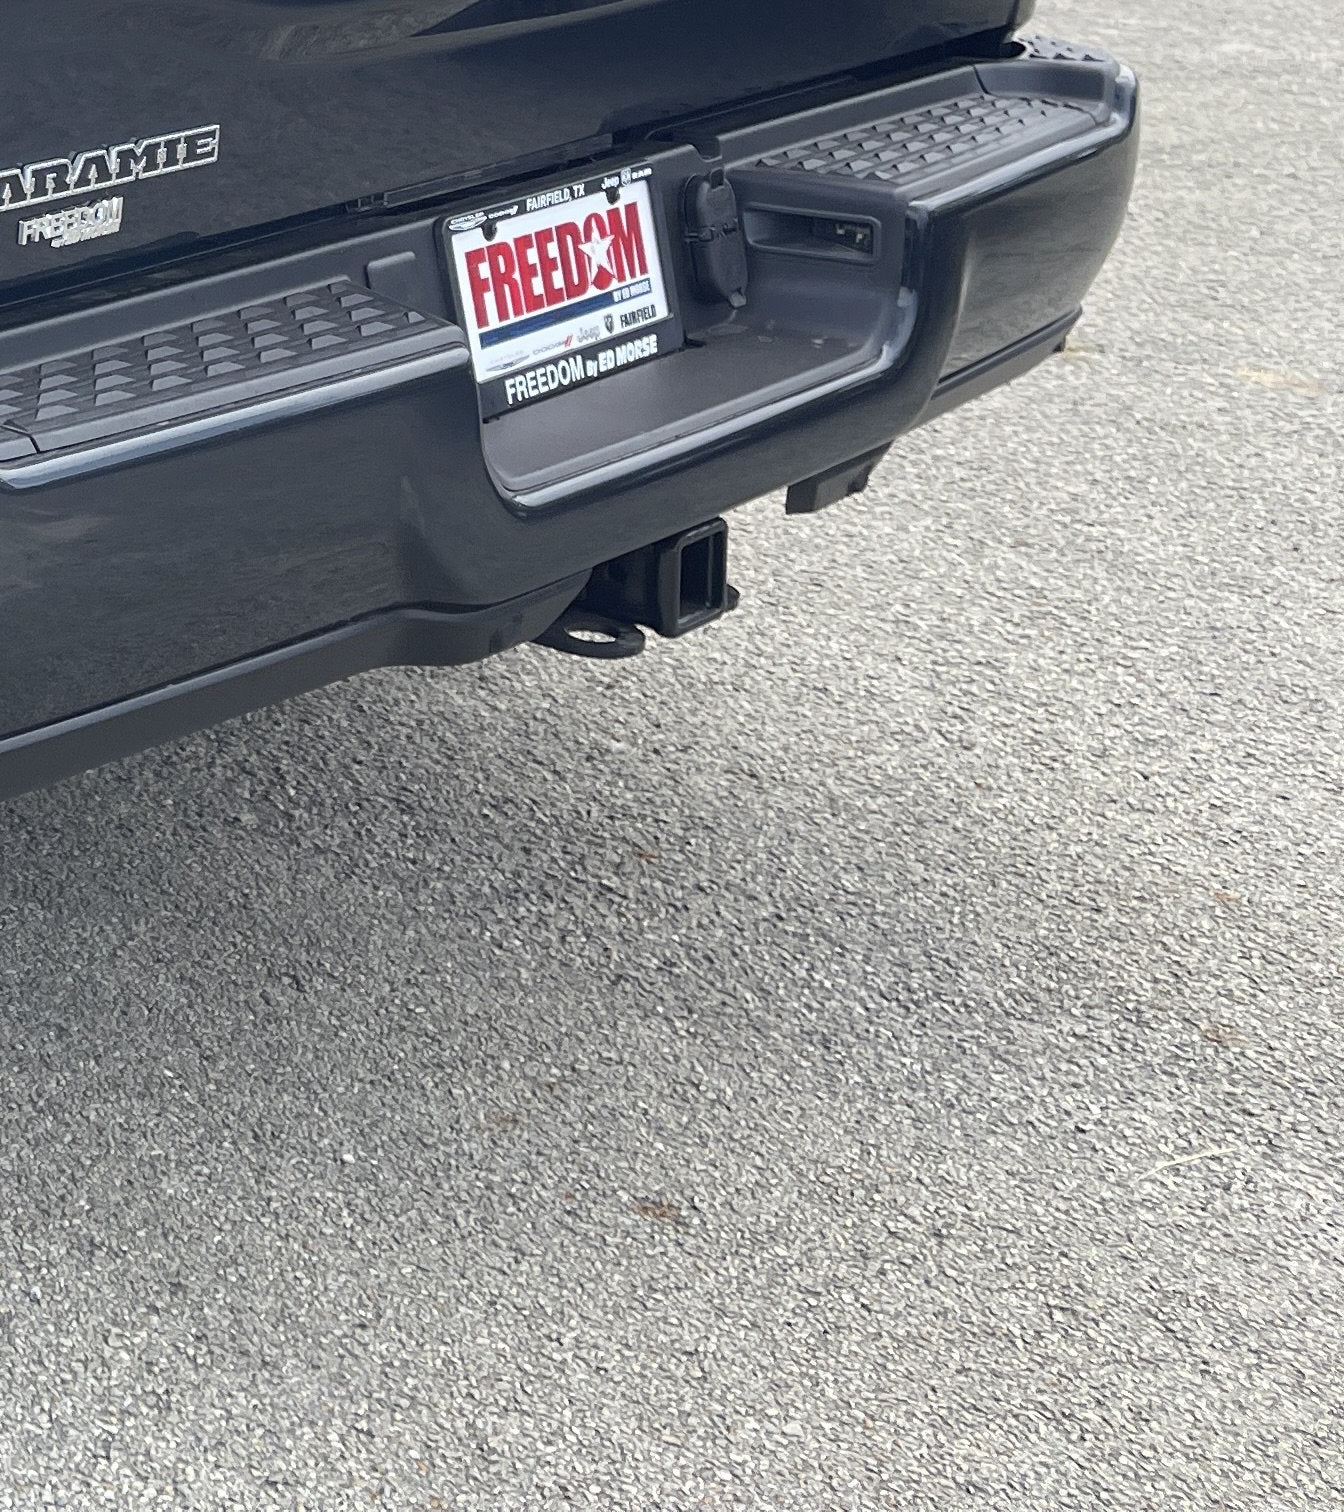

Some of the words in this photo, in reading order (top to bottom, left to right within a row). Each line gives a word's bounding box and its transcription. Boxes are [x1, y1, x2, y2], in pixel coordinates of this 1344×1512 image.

[572, 183, 585, 198] TX
[18, 197, 124, 245] FREEDOM
[465, 201, 649, 329] FREEDOM
[620, 304, 657, 329] FAIRFIELD
[504, 355, 585, 405] FREEDOM
[598, 349, 615, 372] ED
[616, 334, 658, 366] MORSE
